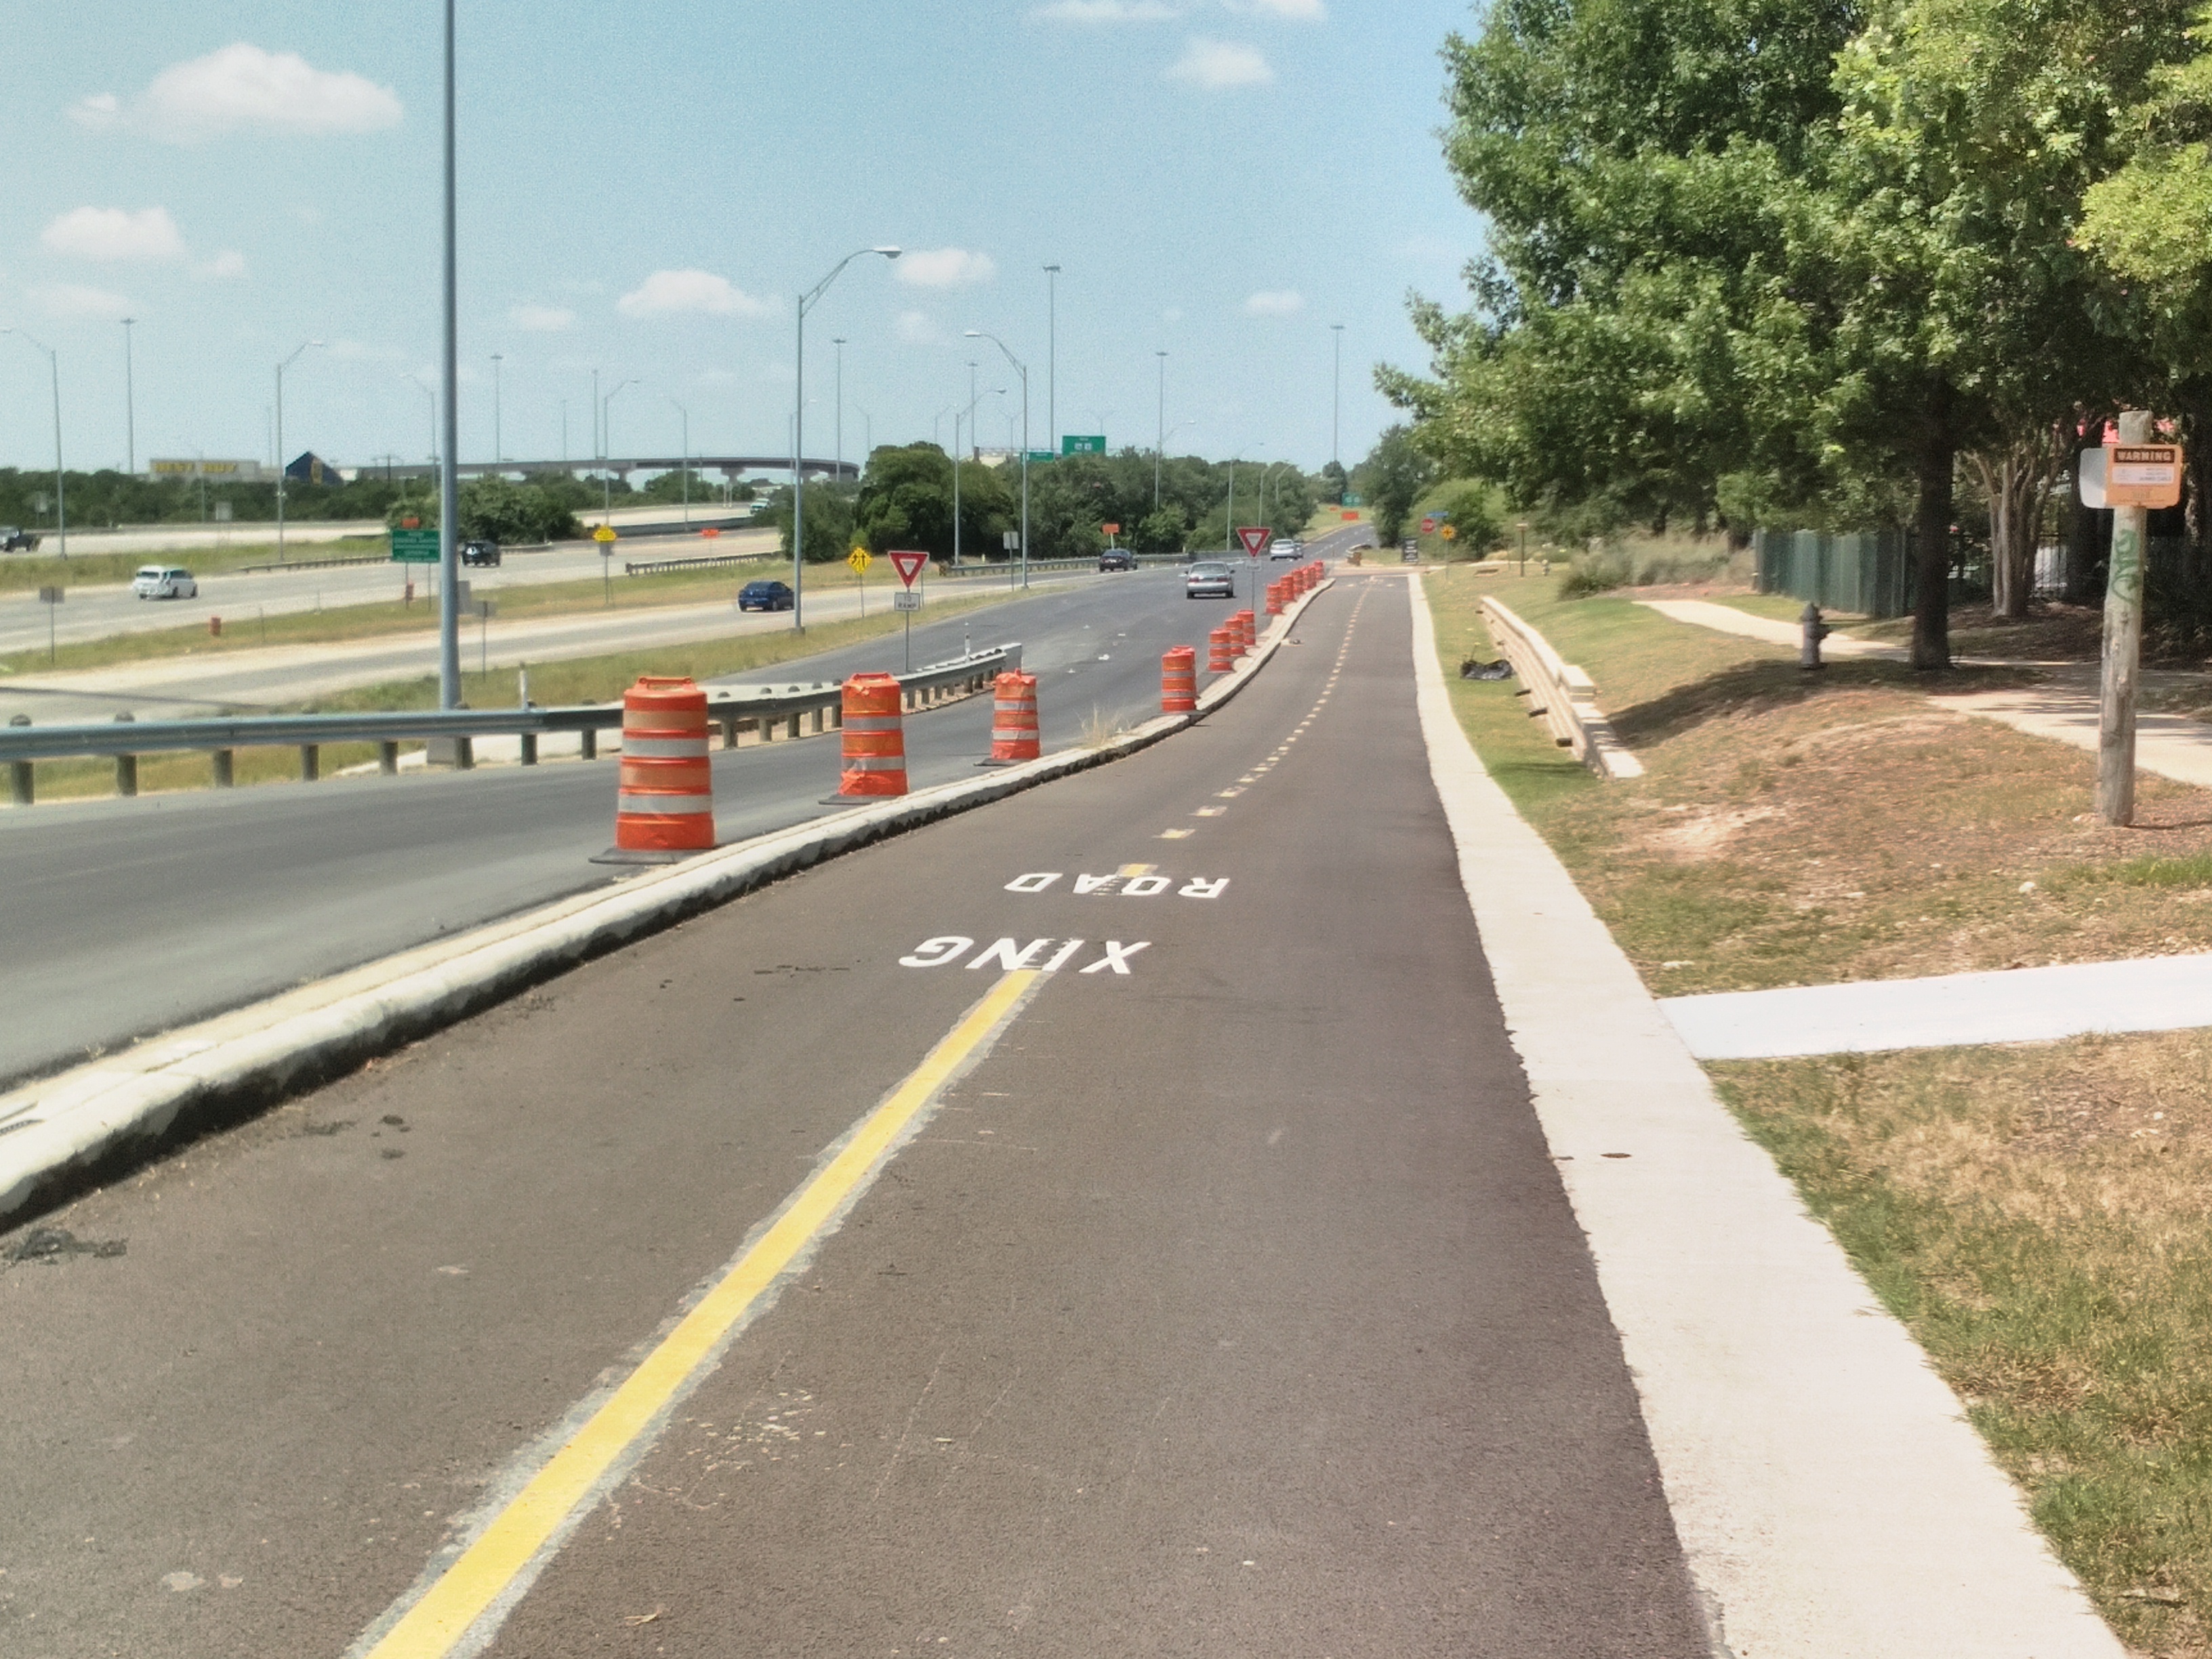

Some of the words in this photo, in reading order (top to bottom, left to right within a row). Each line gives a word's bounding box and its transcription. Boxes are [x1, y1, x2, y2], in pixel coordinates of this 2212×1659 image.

[2117, 451, 2171, 461] WARNING
[1003, 872, 1231, 899] ROAD
[898, 935, 1153, 975] XING
